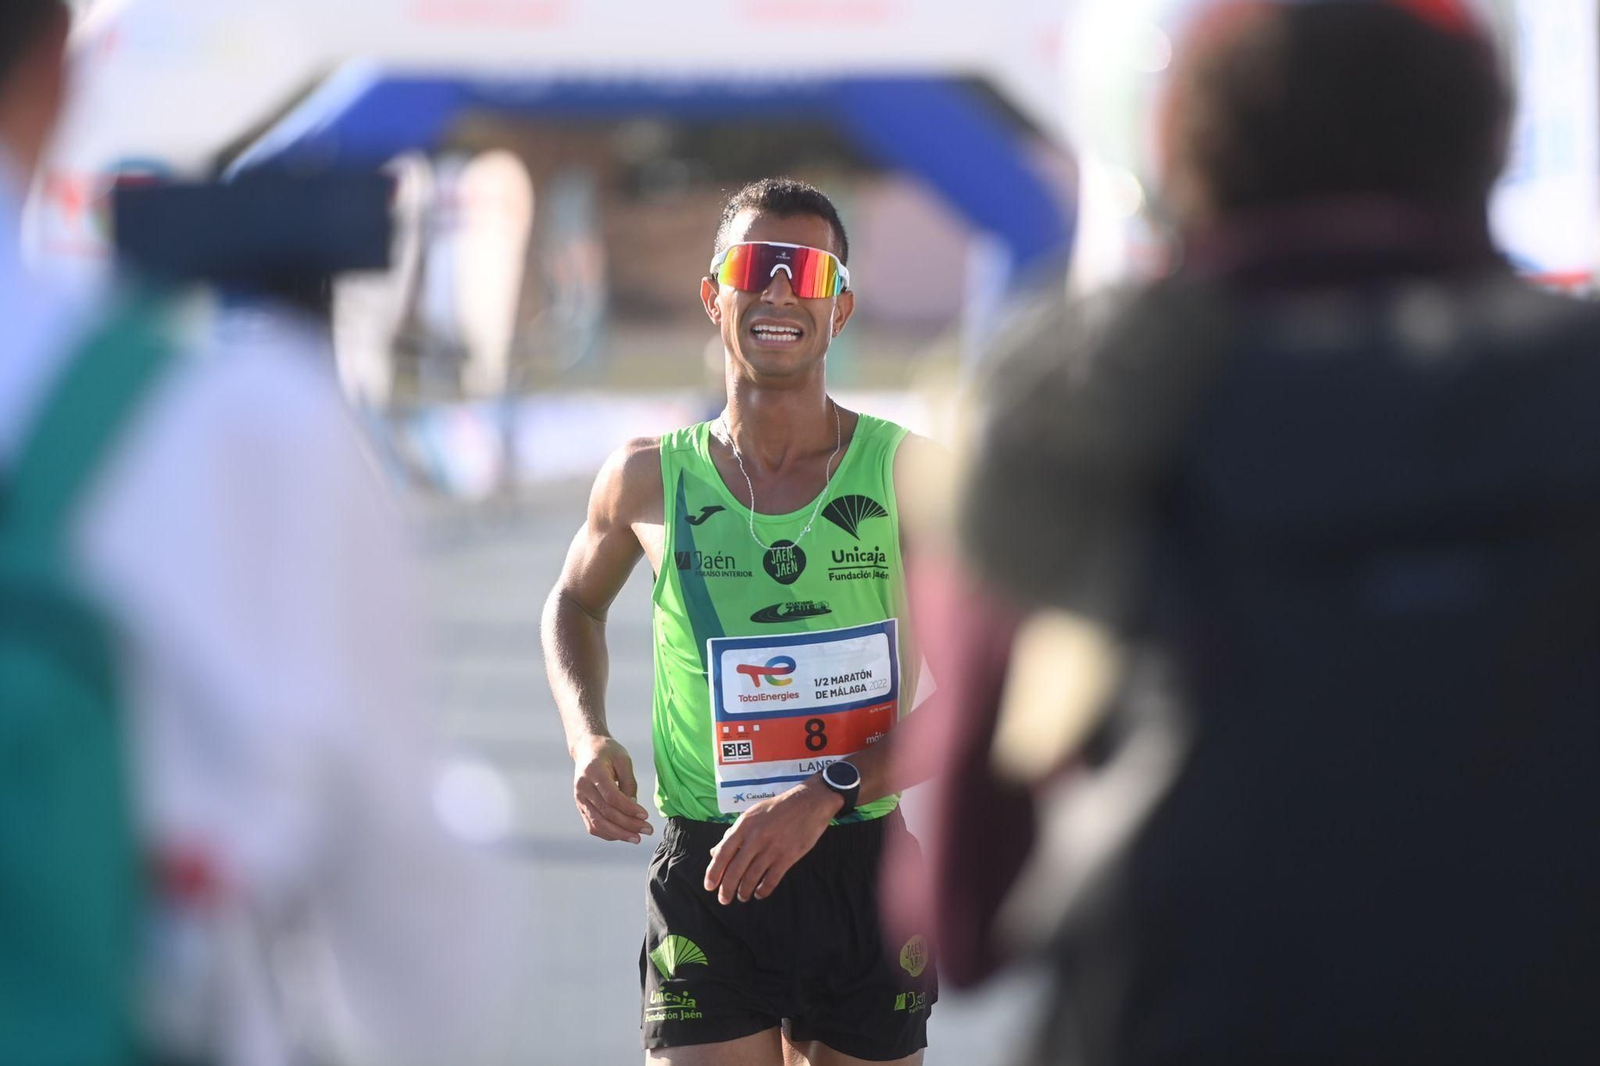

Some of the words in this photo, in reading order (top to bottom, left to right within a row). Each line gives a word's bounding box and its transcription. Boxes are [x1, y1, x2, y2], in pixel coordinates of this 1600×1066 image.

[694, 550, 735, 569] Jaén
[831, 546, 886, 565] Unicaja
[814, 677, 829, 687] 1/2
[831, 669, 873, 685] MARATÓN
[738, 691, 799, 703] TotalEnergies
[815, 690, 828, 700] DE
[830, 683, 867, 698] MÁLAGA
[868, 678, 888, 691] 2022
[804, 718, 828, 752] 8
[746, 792, 776, 800] CaixaBank
[680, 1010, 702, 1021] Jaén
